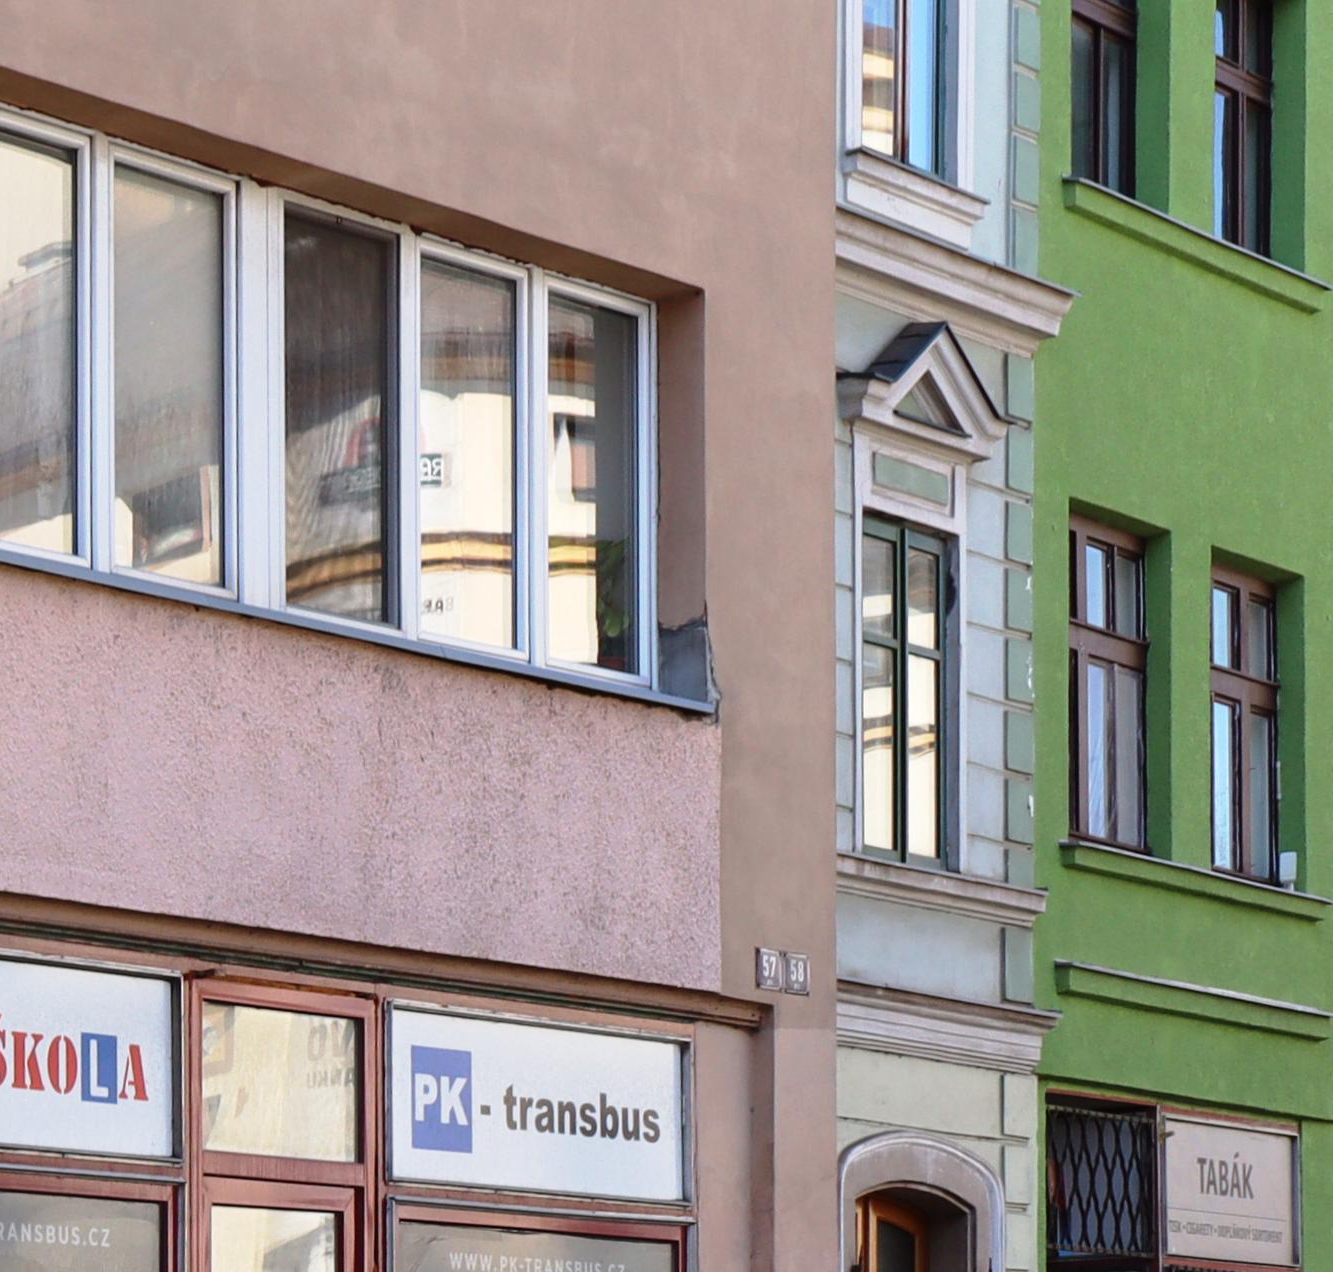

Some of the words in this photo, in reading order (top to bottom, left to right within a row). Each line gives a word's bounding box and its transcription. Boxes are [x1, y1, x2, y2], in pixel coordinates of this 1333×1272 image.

[763, 955, 776, 977] 57
[790, 960, 804, 982] 58
[414, 1073, 468, 1126] PK
[503, 1084, 661, 1143] transbus
[1197, 1151, 1254, 1200] TABÁK
